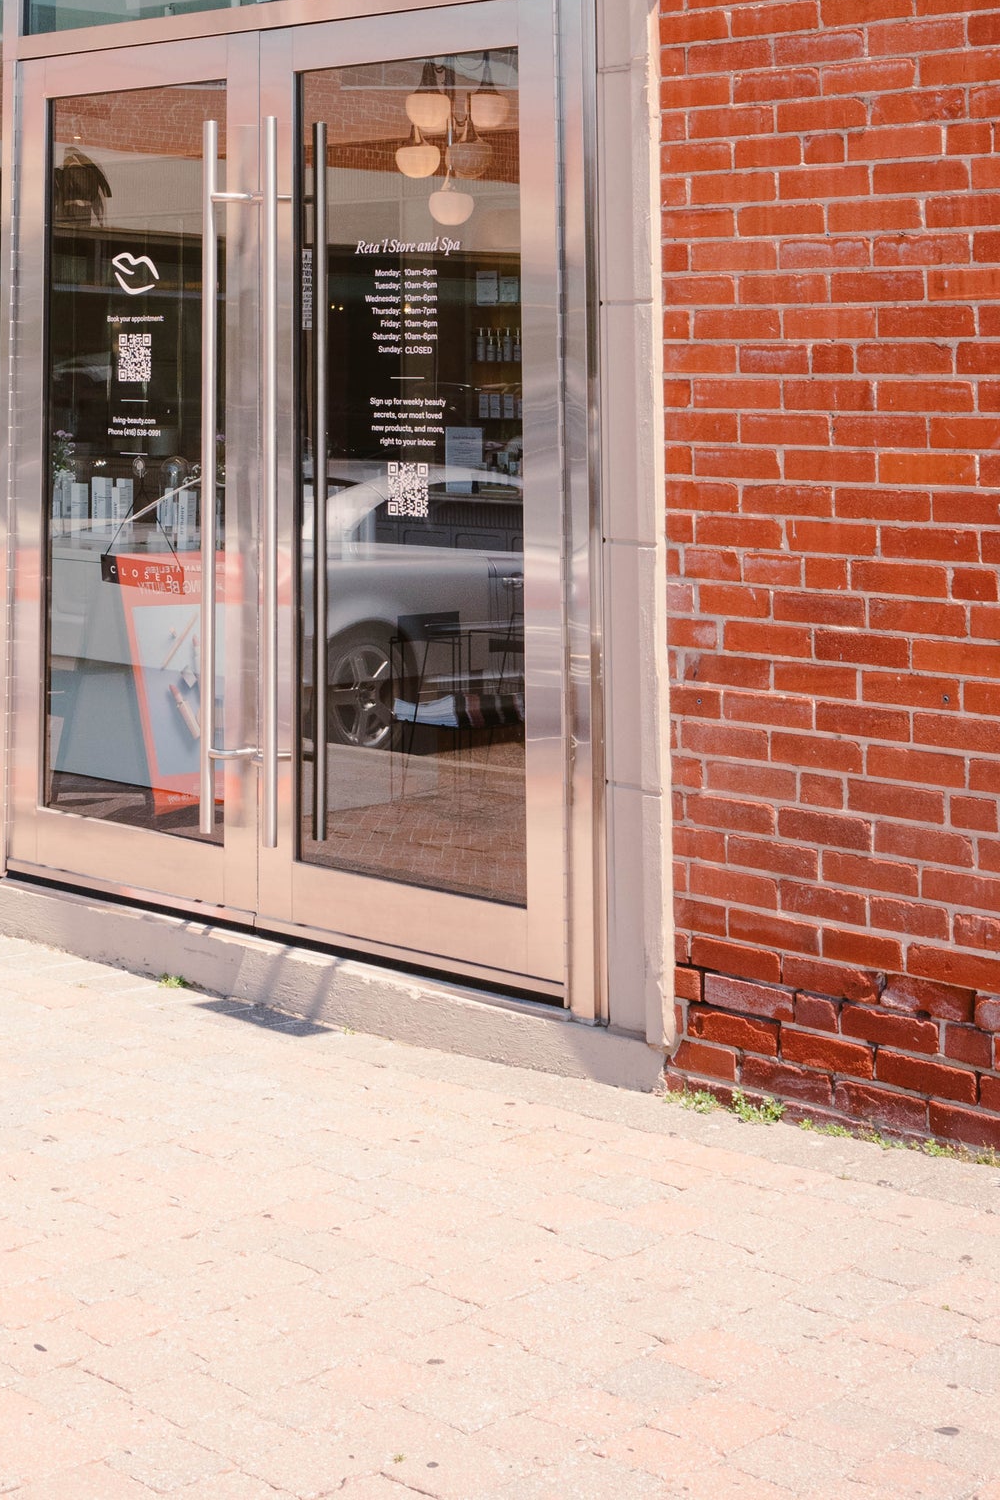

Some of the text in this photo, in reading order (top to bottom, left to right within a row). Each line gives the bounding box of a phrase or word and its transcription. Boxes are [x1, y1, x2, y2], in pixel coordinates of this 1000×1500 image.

[355, 237, 460, 256] Retal Store and Spa
[375, 268, 437, 278] Monday: 10am-6pm
[374, 281, 437, 290] Tuesday: 10am-6pm
[365, 294, 437, 303] Wednesday: 10am-6pm
[372, 307, 401, 316] Thursday:
[380, 320, 437, 328] Friday: 10am-6pm
[372, 332, 437, 341] Saturday: 10am-6pm
[378, 346, 432, 354] Sunday: CLOSED
[370, 397, 384, 406] Sign
[403, 398, 424, 407] weekly
[424, 398, 446, 408] beauty
[113, 416, 156, 425] living-beauty.com
[374, 412, 397, 420] secrets,
[108, 428, 123, 436] Phone
[384, 424, 413, 433] products,
[427, 426, 444, 434] more,
[380, 437, 394, 446] right
[417, 438, 436, 446] inbox:
[110, 566, 173, 584] CLOSED
